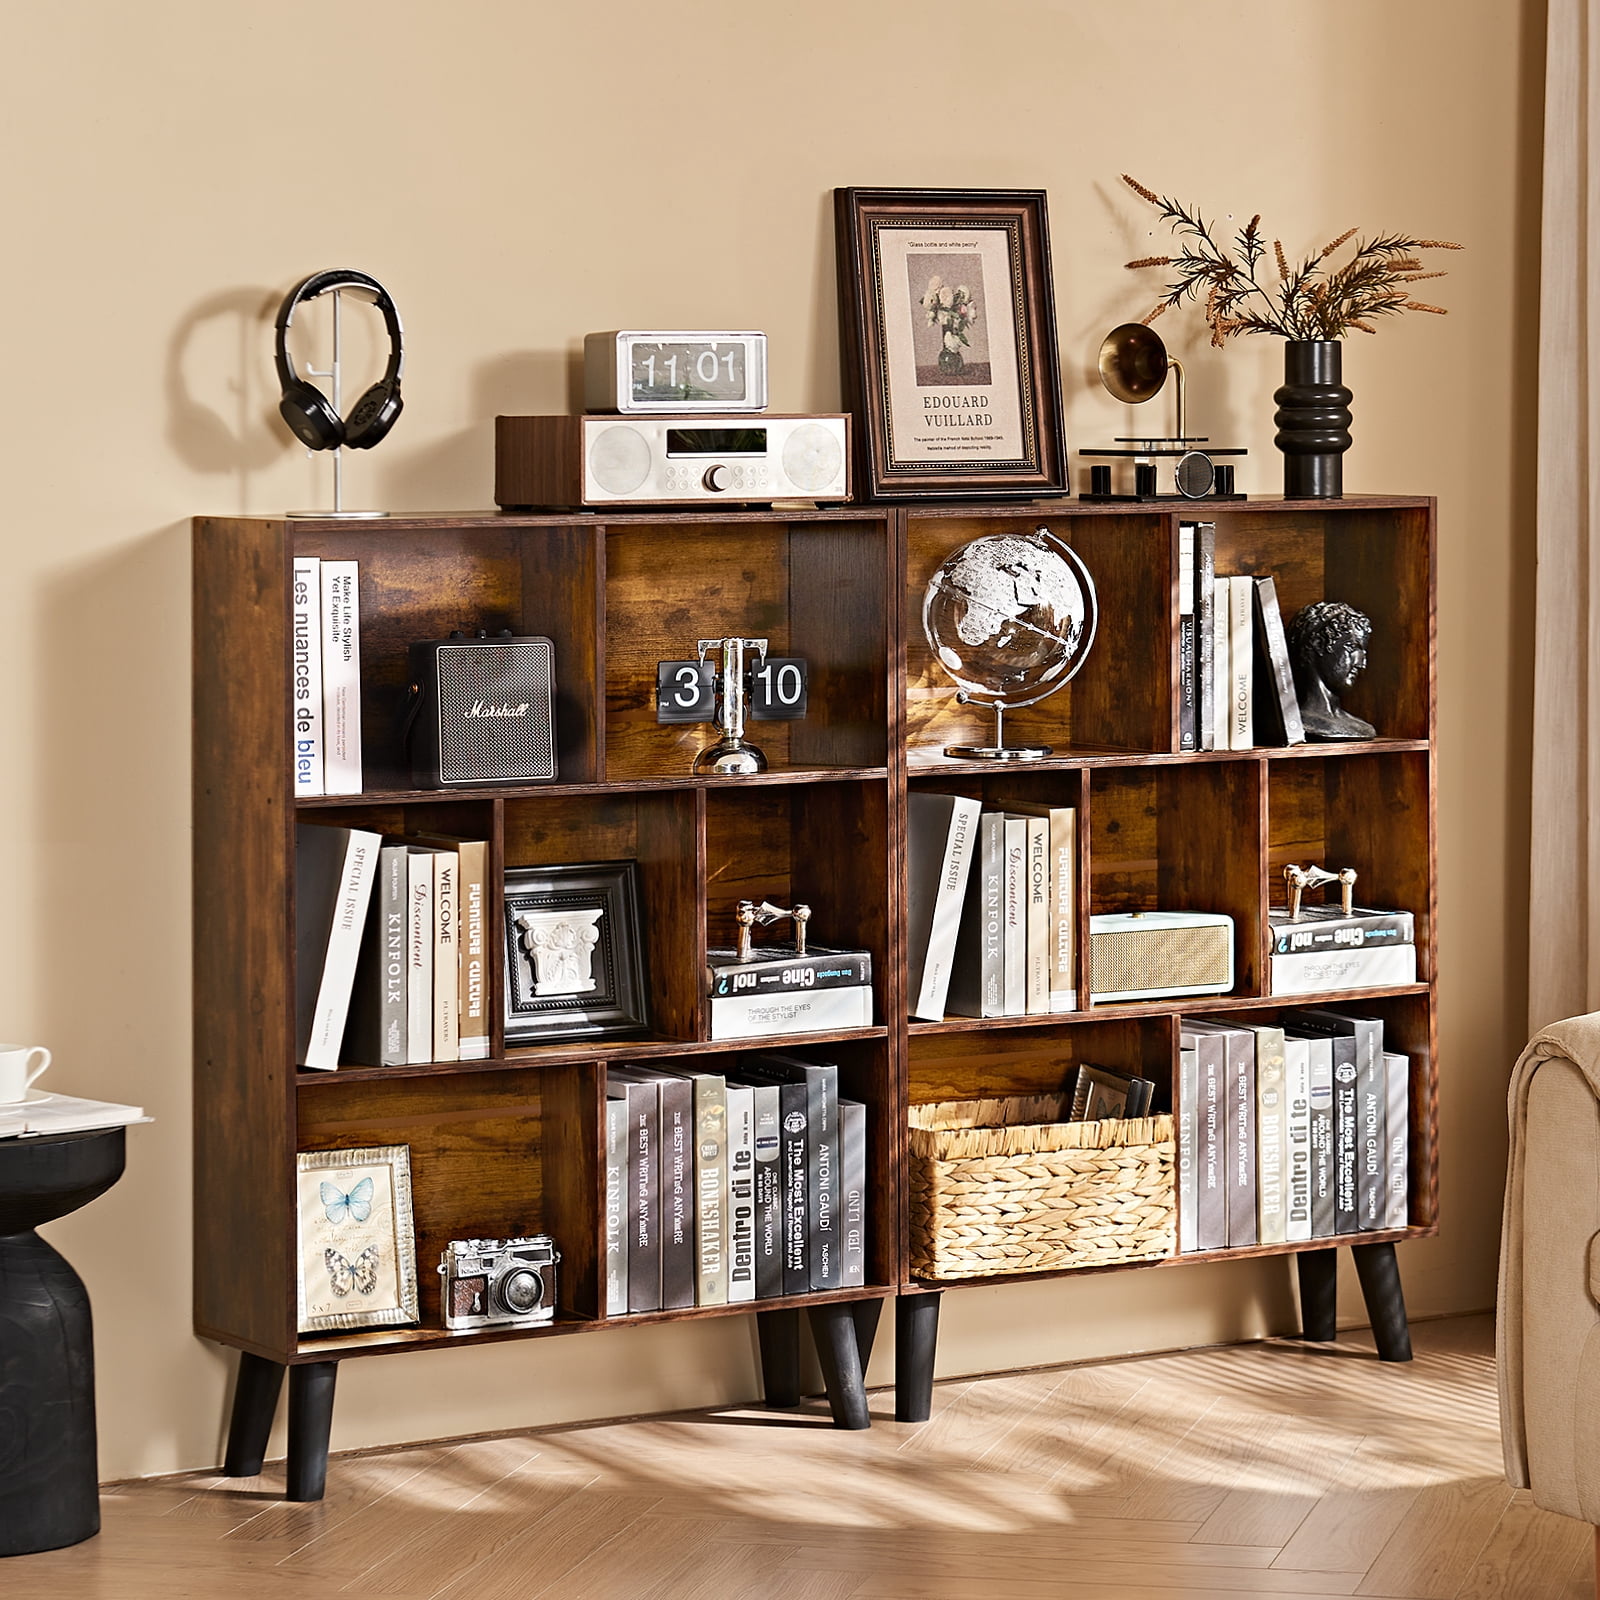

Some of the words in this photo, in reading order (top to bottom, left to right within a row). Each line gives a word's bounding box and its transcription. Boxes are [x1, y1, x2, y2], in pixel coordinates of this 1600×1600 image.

[642, 354, 677, 387] 11
[697, 351, 735, 383] 01
[923, 395, 989, 409] EDOUARD
[924, 413, 993, 427] VUILLARD
[294, 569, 312, 606] Les
[332, 576, 341, 593] Yet
[342, 576, 352, 604] Make
[330, 596, 341, 643] Exquisite
[342, 606, 352, 625] Life
[1266, 607, 1284, 650] Design
[295, 612, 310, 700] nuances
[341, 627, 353, 662] Stylish
[674, 666, 701, 708] 3
[757, 664, 803, 706] 10
[1185, 658, 1193, 708] HARMONY
[297, 707, 315, 733] de
[464, 699, 529, 719] Marshall
[1238, 673, 1248, 736] WELCOME
[297, 739, 316, 784] bleu
[953, 812, 970, 858] SPECIAL
[348, 847, 366, 893] SPECIAL
[946, 861, 962, 892] ISSUE
[1032, 832, 1043, 904] WELCOME
[1058, 847, 1069, 914] FURNITURE
[1009, 847, 1022, 929] Discontent
[341, 897, 357, 931] ISSUE
[440, 867, 452, 944] WELCOME
[468, 882, 481, 955] FURNITURE
[987, 874, 999, 959] KINFOLK
[414, 883, 427, 969] Discontent
[1289, 932, 1313, 952] noi
[1334, 928, 1365, 947] Cine
[388, 912, 401, 1004] KINFOLK
[1058, 918, 1069, 974] CULTURE
[468, 959, 481, 1018] CULTURE
[718, 972, 729, 995] ?
[732, 972, 757, 993] noi
[782, 967, 815, 987] Cine
[748, 1006, 779, 1015] THROUGH
[780, 1005, 793, 1013] THE
[757, 1013, 771, 1021] THE
[771, 1011, 797, 1020] STYLIST
[1208, 1077, 1217, 1102] BEST
[1239, 1075, 1248, 1100] BEST
[1344, 1088, 1355, 1115] The
[1291, 1098, 1307, 1119] te
[1366, 1092, 1377, 1137] ANTONI
[639, 1128, 649, 1156] BEST
[674, 1126, 684, 1153] BEST
[1289, 1125, 1307, 1144] di
[1318, 1113, 1327, 1148] AROUND
[1344, 1116, 1355, 1149] Most
[733, 1150, 752, 1172] te
[794, 1138, 804, 1166] The
[819, 1143, 830, 1190] ANTONI
[1180, 1111, 1191, 1194] KINFOLK
[1262, 1113, 1281, 1216] BONESHAKER
[1318, 1150, 1327, 1167] THE
[1366, 1139, 1379, 1176] GAUDÍ
[1393, 1136, 1404, 1168] LIND
[731, 1179, 752, 1199] di
[764, 1166, 772, 1203] AROUND
[794, 1169, 804, 1203] Most
[1289, 1151, 1307, 1222] Dentro
[1318, 1167, 1327, 1198] WORLD
[1344, 1151, 1355, 1212] Excellent
[1393, 1173, 1404, 1197] JED
[606, 1166, 620, 1254] KINFOLK
[764, 1204, 772, 1222] THE
[819, 1192, 832, 1231] GAUDÍ
[848, 1190, 860, 1223] LIND
[1368, 1187, 1376, 1219] TASCHEN
[701, 1168, 720, 1275] BONESHAKER
[794, 1206, 805, 1270] Excellent
[732, 1206, 752, 1282] Dentro
[764, 1224, 773, 1256] WORLD
[848, 1229, 861, 1253] JED
[821, 1243, 829, 1279] TASCHEN
